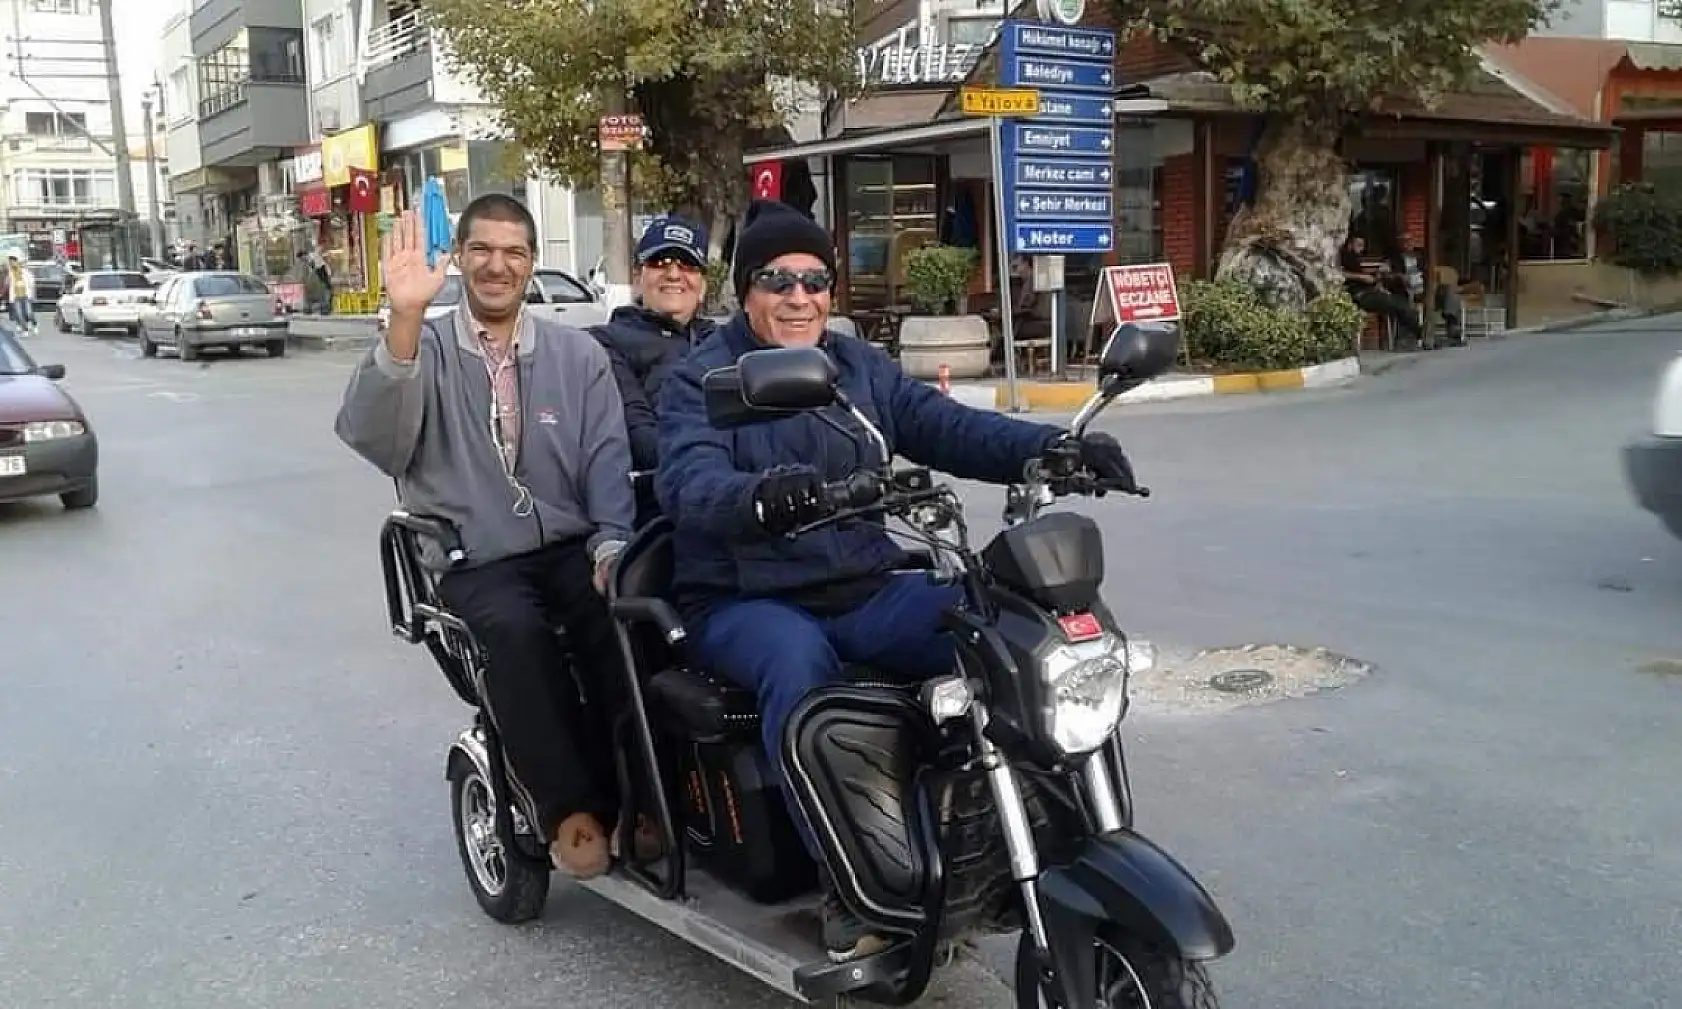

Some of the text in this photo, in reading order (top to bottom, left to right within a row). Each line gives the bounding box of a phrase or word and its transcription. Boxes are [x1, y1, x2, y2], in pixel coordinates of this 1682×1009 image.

[982, 95, 1034, 110] Yalova
[1024, 130, 1070, 149] Emniyet
[1024, 164, 1095, 181] Merkez cami
[1030, 230, 1074, 246] Noter
[1119, 289, 1172, 307] ECZANE
